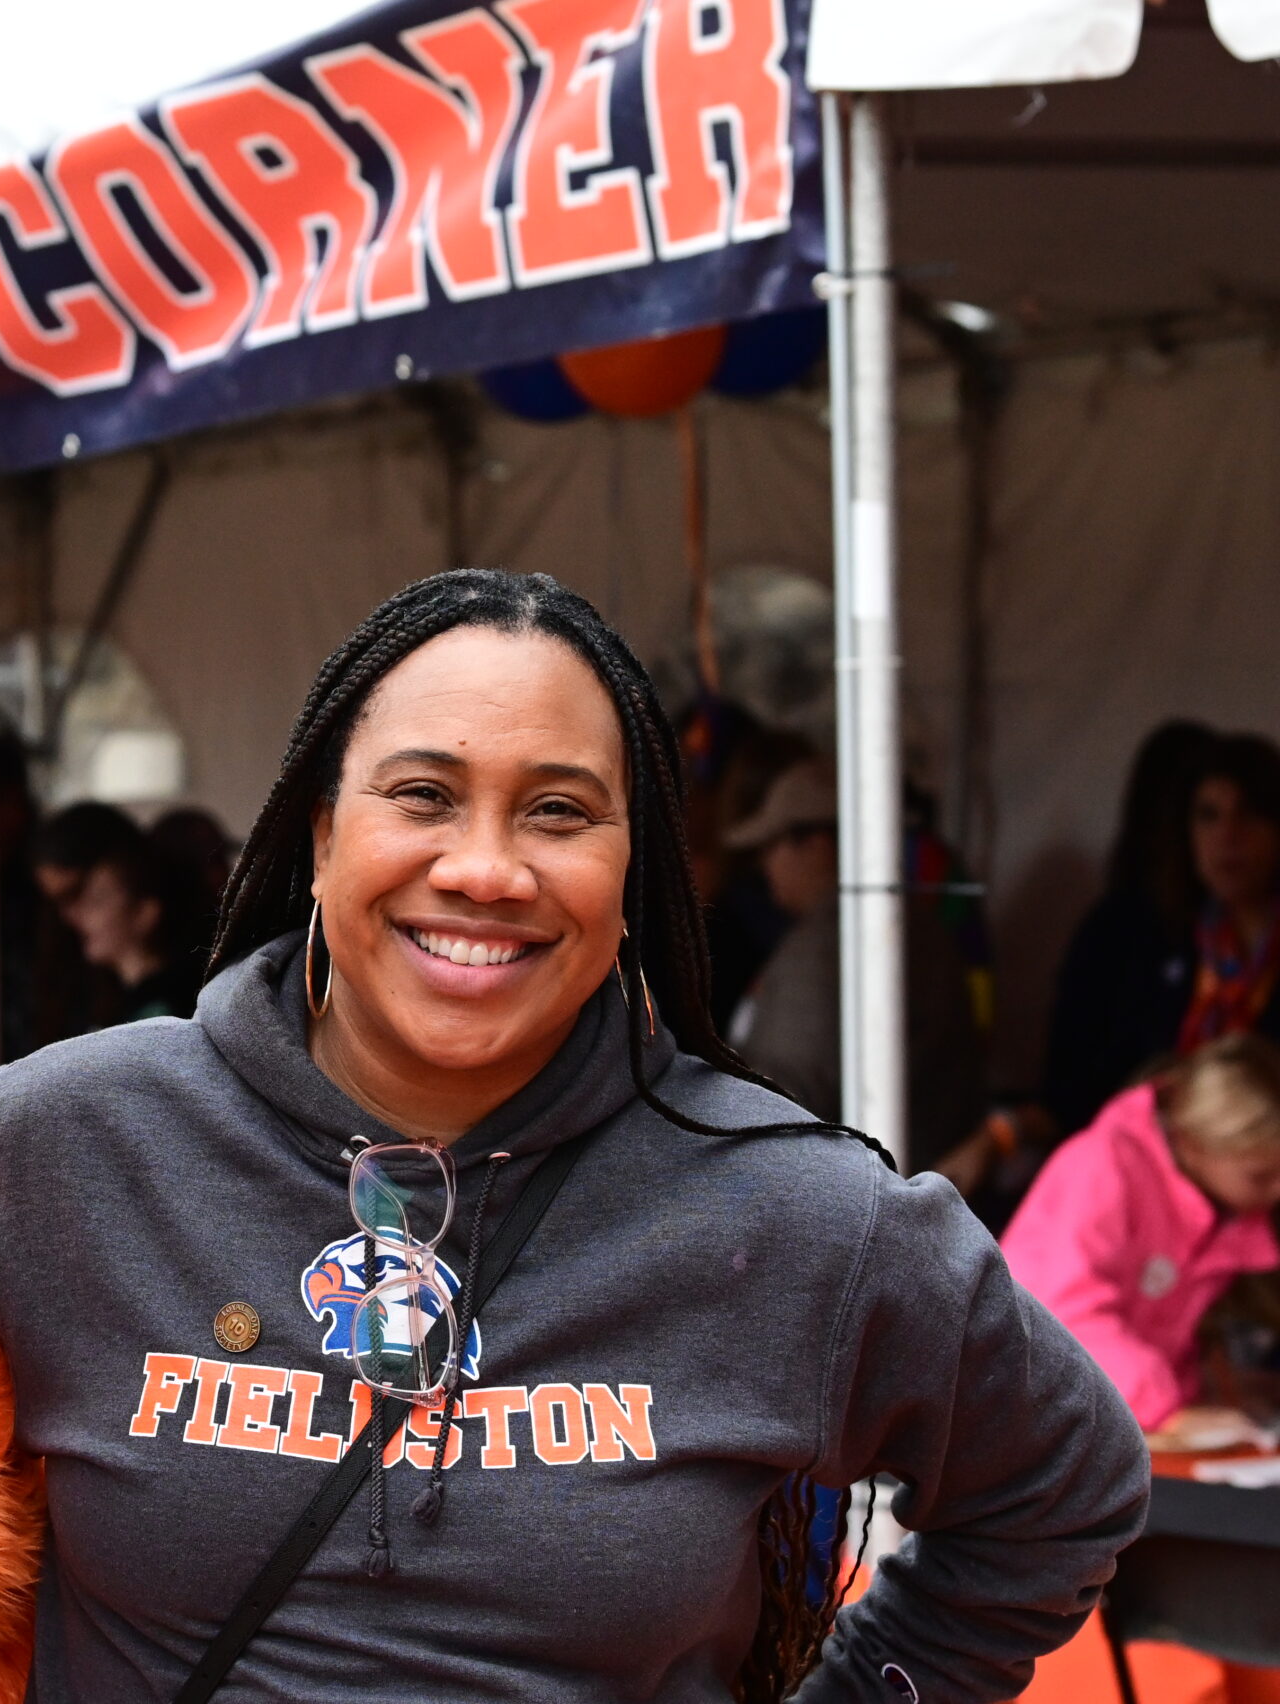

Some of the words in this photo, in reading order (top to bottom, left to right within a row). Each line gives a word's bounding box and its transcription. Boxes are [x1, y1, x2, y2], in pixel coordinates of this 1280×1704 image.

[221, 1304, 246, 1317] LOYAL
[229, 1318, 245, 1336] 10
[249, 1316, 258, 1339] OAKS
[215, 1325, 242, 1350] SOCIETY
